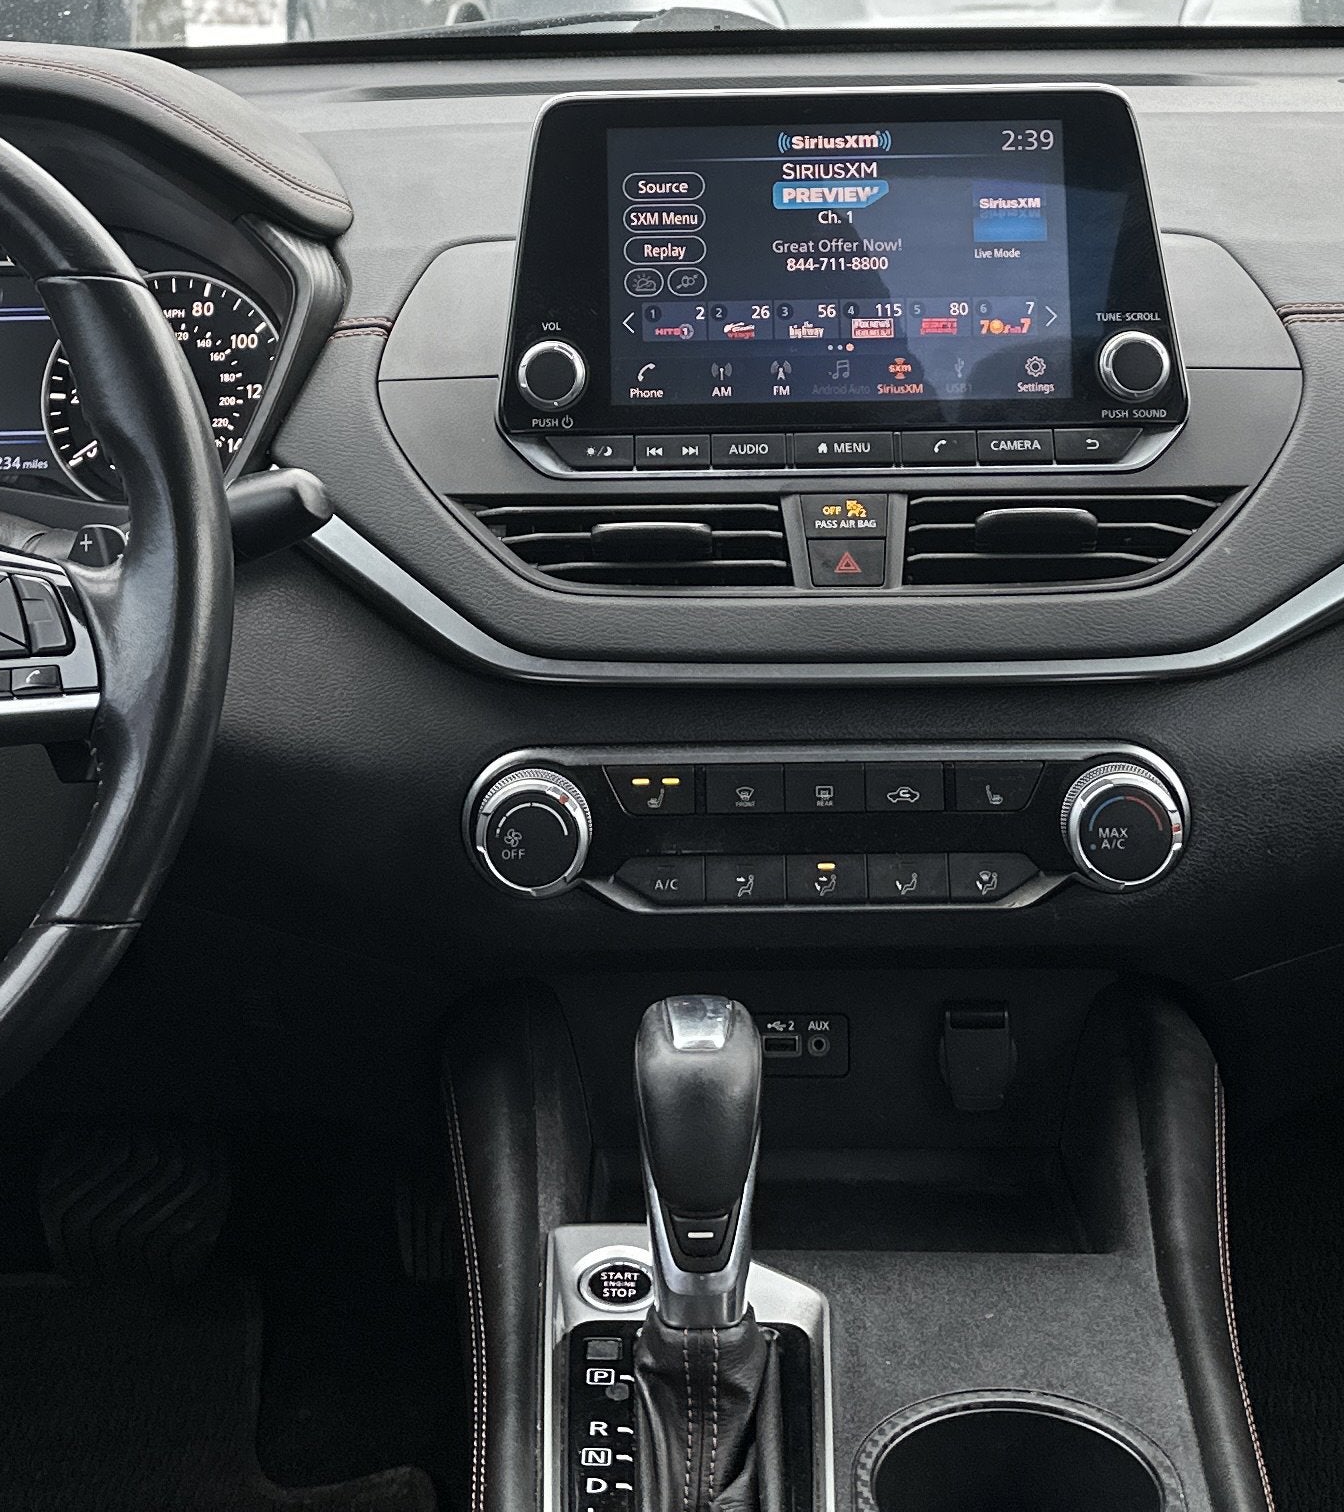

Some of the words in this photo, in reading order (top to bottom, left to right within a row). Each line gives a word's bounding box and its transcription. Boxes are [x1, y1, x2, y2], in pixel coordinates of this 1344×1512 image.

[1001, 129, 1055, 151] 2:39
[782, 162, 878, 179] SIRIUSXM
[637, 180, 689, 194] Source
[782, 186, 881, 204] PREVIEW
[979, 197, 1042, 209] SiriusXM
[630, 212, 659, 226] SXM
[662, 211, 698, 226] Menu
[817, 210, 842, 225] Ch.
[846, 210, 854, 224] 1
[643, 243, 687, 261] Replay
[772, 240, 815, 254] Great
[818, 239, 859, 253] Offer
[862, 238, 904, 253] Now!
[974, 248, 993, 259] Live
[994, 248, 1021, 259] Mode
[786, 257, 889, 271] 844-711-8800
[162, 308, 186, 319] MPH
[192, 301, 214, 317] 80
[649, 308, 656, 319] 1
[695, 307, 705, 320] 2
[714, 308, 723, 318] 2
[751, 305, 771, 319] 26
[781, 306, 789, 317] 3
[817, 304, 837, 318] 56
[847, 305, 855, 316] 4
[875, 303, 903, 317] 115
[913, 304, 921, 314] 5
[949, 302, 969, 316] 80
[979, 303, 987, 314] 6
[1025, 301, 1035, 315] 7
[541, 321, 562, 332] VOL
[196, 338, 212, 348] 140
[230, 333, 258, 349] 100
[209, 352, 226, 362] 160
[219, 373, 236, 382] 180
[629, 388, 664, 399] Phone
[711, 385, 732, 397] AM
[773, 385, 790, 396] FM
[876, 383, 924, 395] SiriusXM
[1017, 381, 1056, 395] Settings
[219, 397, 236, 406] 200
[1101, 408, 1129, 419] PUSH
[1133, 407, 1167, 419] SOUND
[212, 418, 229, 428] 220
[531, 418, 559, 429] PUSH
[728, 443, 770, 455] AUDIO
[833, 441, 871, 454] MENU
[990, 439, 1042, 451] CAMERA
[22, 459, 49, 470] miles
[822, 506, 842, 516] OFF
[814, 520, 838, 529] PASS
[839, 520, 856, 529] AIR
[857, 519, 877, 528] BAG
[815, 798, 834, 807] REAR
[1098, 827, 1129, 839] MAX
[1100, 838, 1126, 851] A/C
[501, 848, 526, 861] OFF
[654, 878, 679, 891] A/C
[807, 1020, 831, 1031] AUX
[600, 1271, 641, 1282] START
[601, 1288, 637, 1298] STOP
[594, 1371, 608, 1383] P
[589, 1421, 608, 1436] R
[587, 1451, 605, 1463] N
[586, 1478, 608, 1494] D
